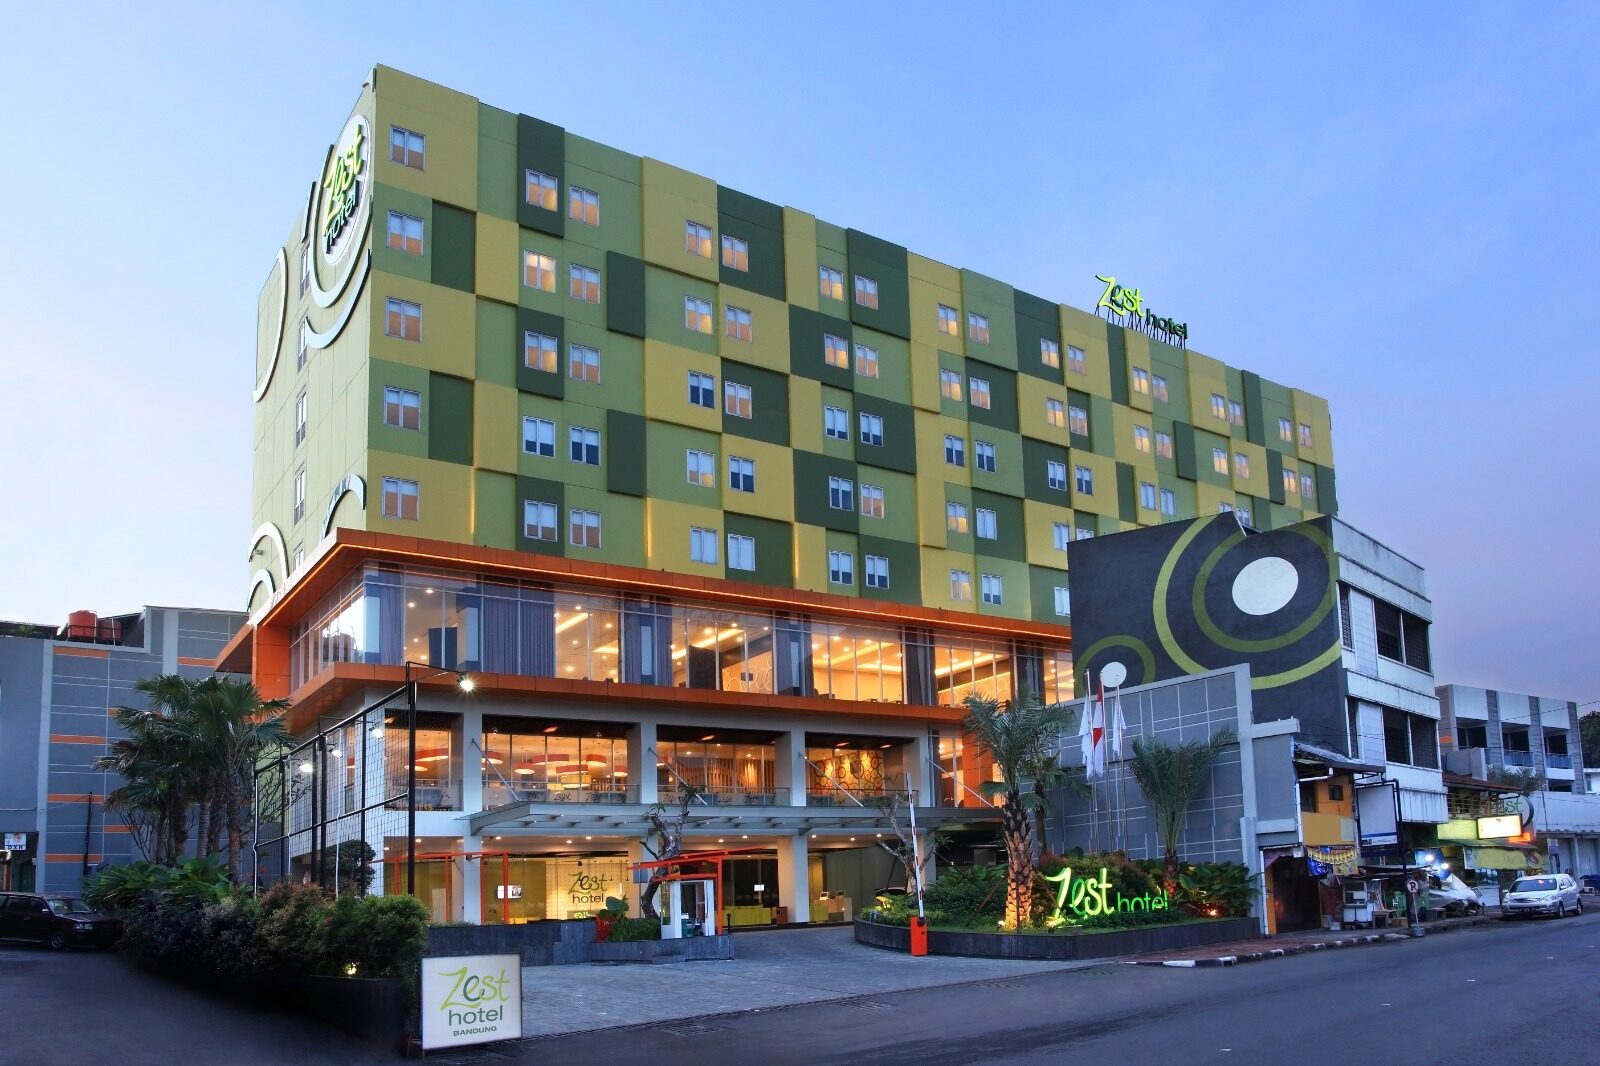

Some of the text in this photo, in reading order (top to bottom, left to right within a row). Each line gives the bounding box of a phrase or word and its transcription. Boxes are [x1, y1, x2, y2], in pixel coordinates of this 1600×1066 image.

[1095, 274, 1188, 340] Zest hotel
[567, 871, 608, 895] Zest
[572, 893, 604, 904] hotel
[1045, 867, 1168, 927] Zest hotel
[438, 966, 511, 1012] Zest
[448, 1005, 503, 1026] hotel
[453, 1026, 497, 1037] BANDUNG
